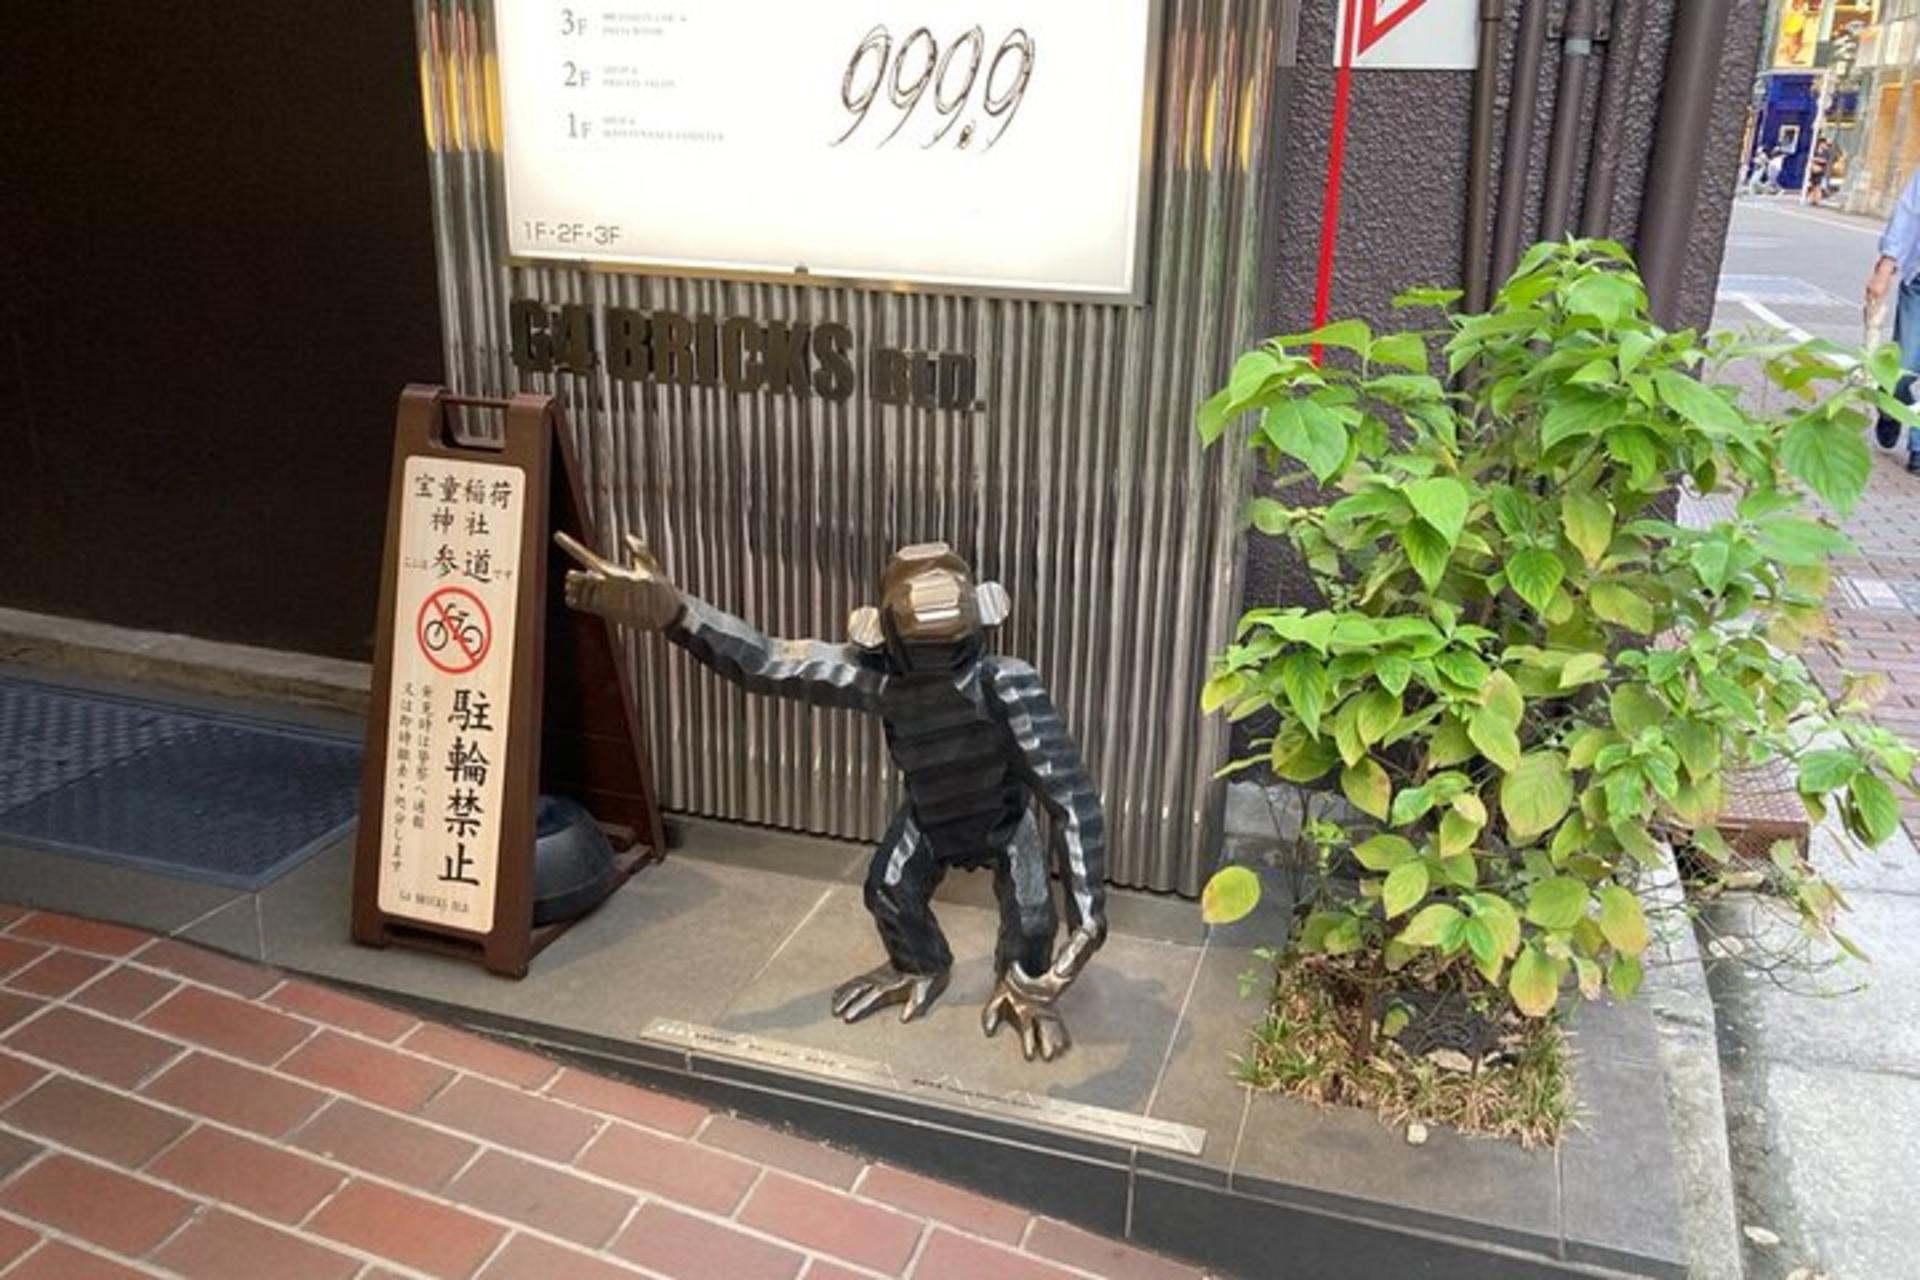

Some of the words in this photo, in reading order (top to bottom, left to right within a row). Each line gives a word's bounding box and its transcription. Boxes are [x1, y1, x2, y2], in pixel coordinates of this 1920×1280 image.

[560, 8, 587, 36] 3F
[562, 60, 590, 87] 2F
[567, 112, 592, 139] 1F
[604, 304, 855, 402] BRICKS
[430, 506, 489, 536] 神社
[431, 543, 491, 583] 参道
[437, 688, 494, 887] 駐輪禁止
